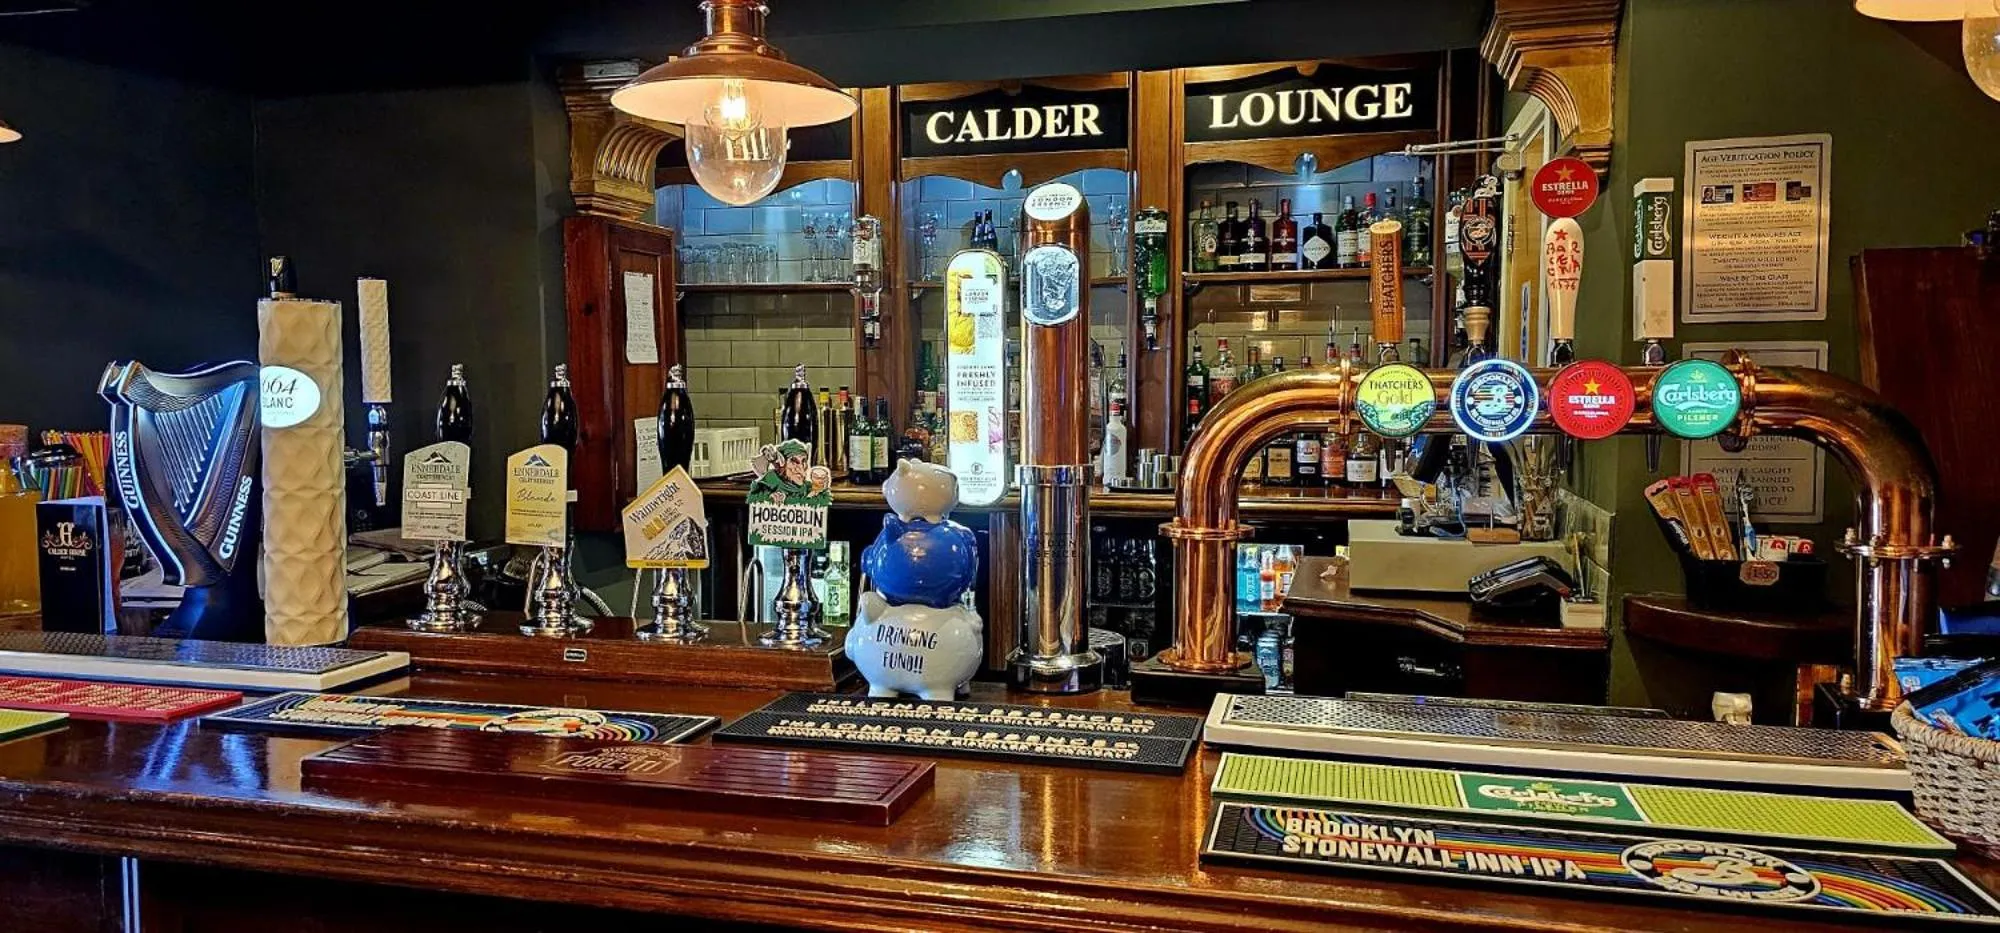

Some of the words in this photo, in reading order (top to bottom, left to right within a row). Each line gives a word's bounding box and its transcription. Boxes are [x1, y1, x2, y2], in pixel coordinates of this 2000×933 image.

[1208, 82, 1413, 129] LOUNGE
[926, 103, 1104, 144] CALDER
[1701, 155, 1717, 163] AGE
[1719, 151, 1780, 162] VERIFICATION
[1783, 150, 1814, 159] POLICY
[1542, 180, 1589, 191] ESTRELLA
[1648, 196, 1670, 256] Carlsberg
[1380, 236, 1395, 316] THATCHERS
[1369, 379, 1424, 390] THATCHERS
[1374, 390, 1413, 406] Gold
[1568, 395, 1615, 404] ESTRELLA
[1658, 383, 1737, 410] Carlsberg
[116, 431, 139, 509] GUINNESS
[513, 467, 560, 477] ENNERDALE
[407, 491, 437, 499] COAST
[440, 491, 460, 500] LINE
[515, 488, 557, 502] Blonde
[628, 480, 681, 524] Wainwright
[219, 475, 253, 559] GUINNESS
[752, 506, 824, 528] HOBGOBLIN
[762, 524, 798, 536] SESSION
[799, 527, 813, 537] IPA
[883, 652, 924, 674] FUND!!
[1285, 817, 1437, 846] BROOKLYN
[1282, 835, 1459, 869] STONEWALL
[1467, 852, 1526, 875] INN
[1529, 857, 1587, 880] IPA
